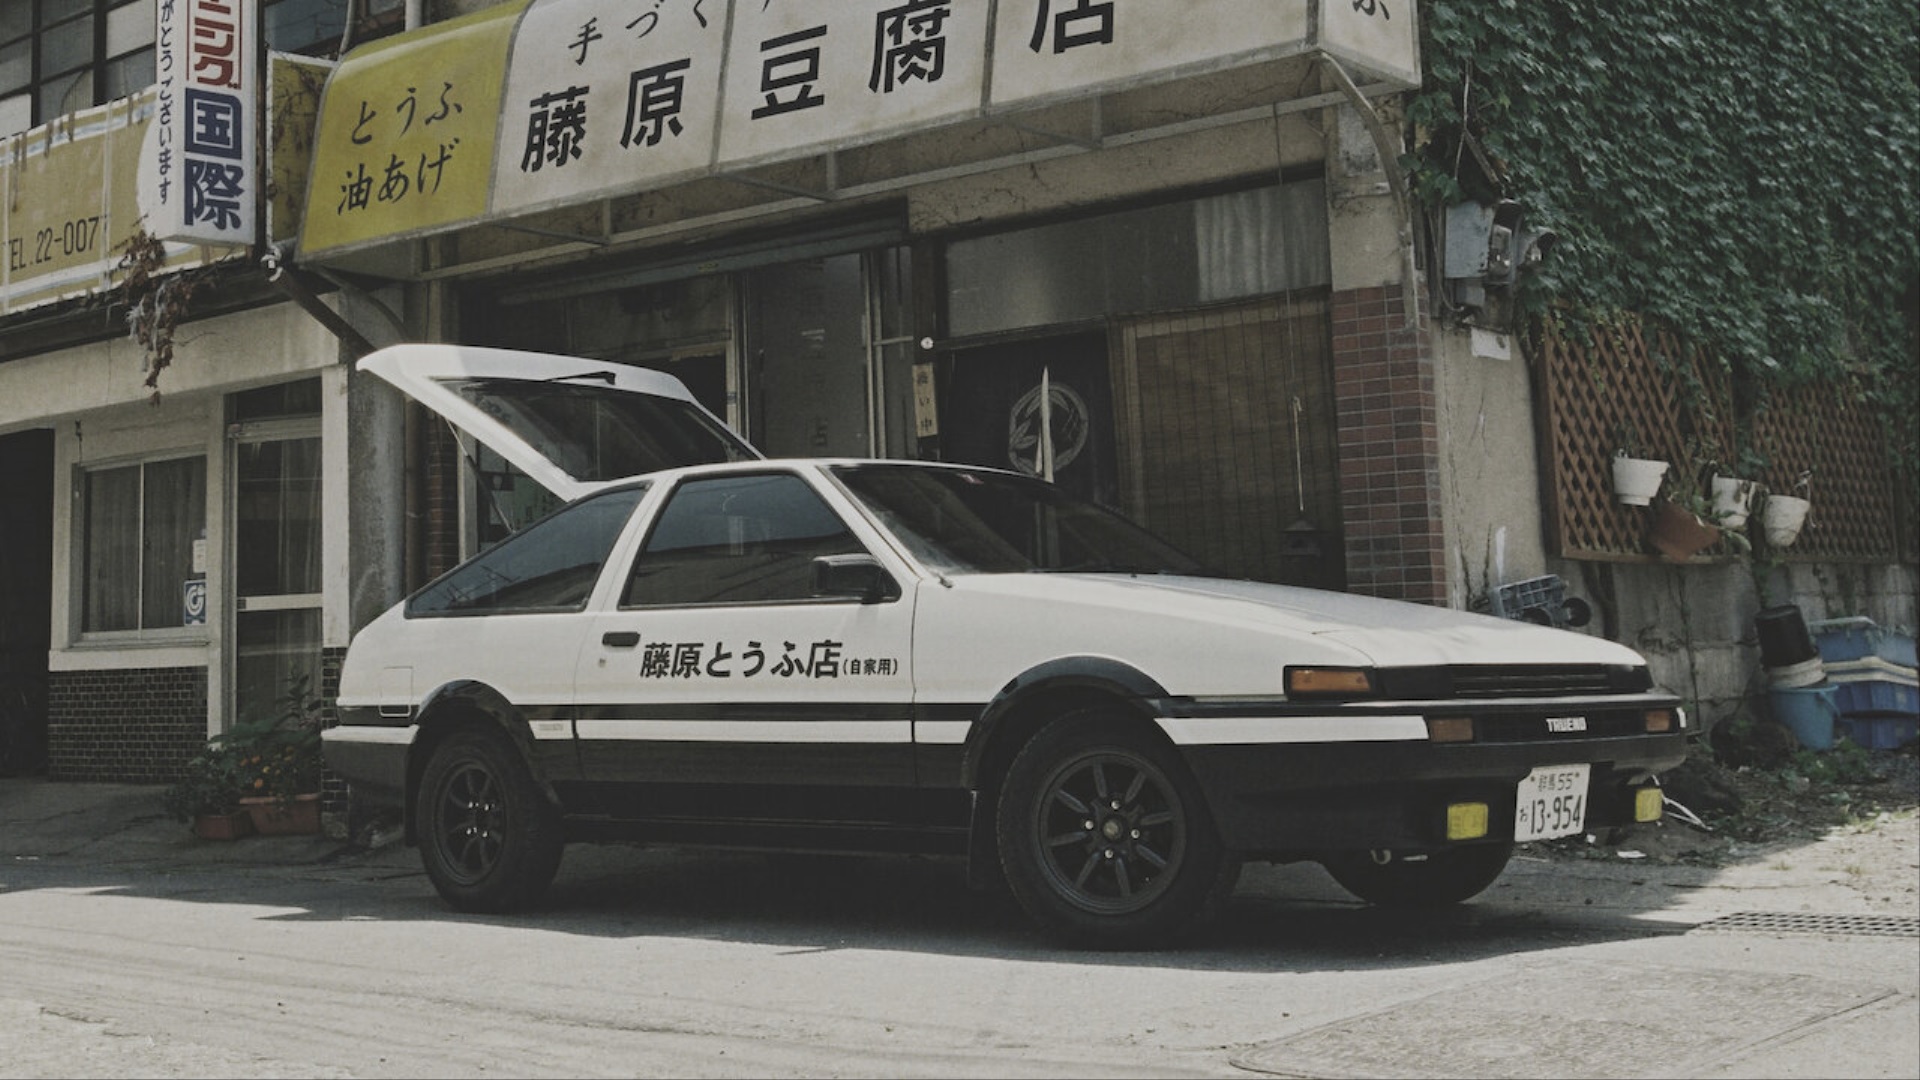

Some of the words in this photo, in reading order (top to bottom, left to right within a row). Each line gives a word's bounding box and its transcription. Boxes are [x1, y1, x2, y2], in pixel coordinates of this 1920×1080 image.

[567, 0, 771, 67] 手づく
[351, 81, 463, 145] とうふ
[337, 137, 460, 216] 油あげ
[1545, 717, 1587, 733] TRUENO
